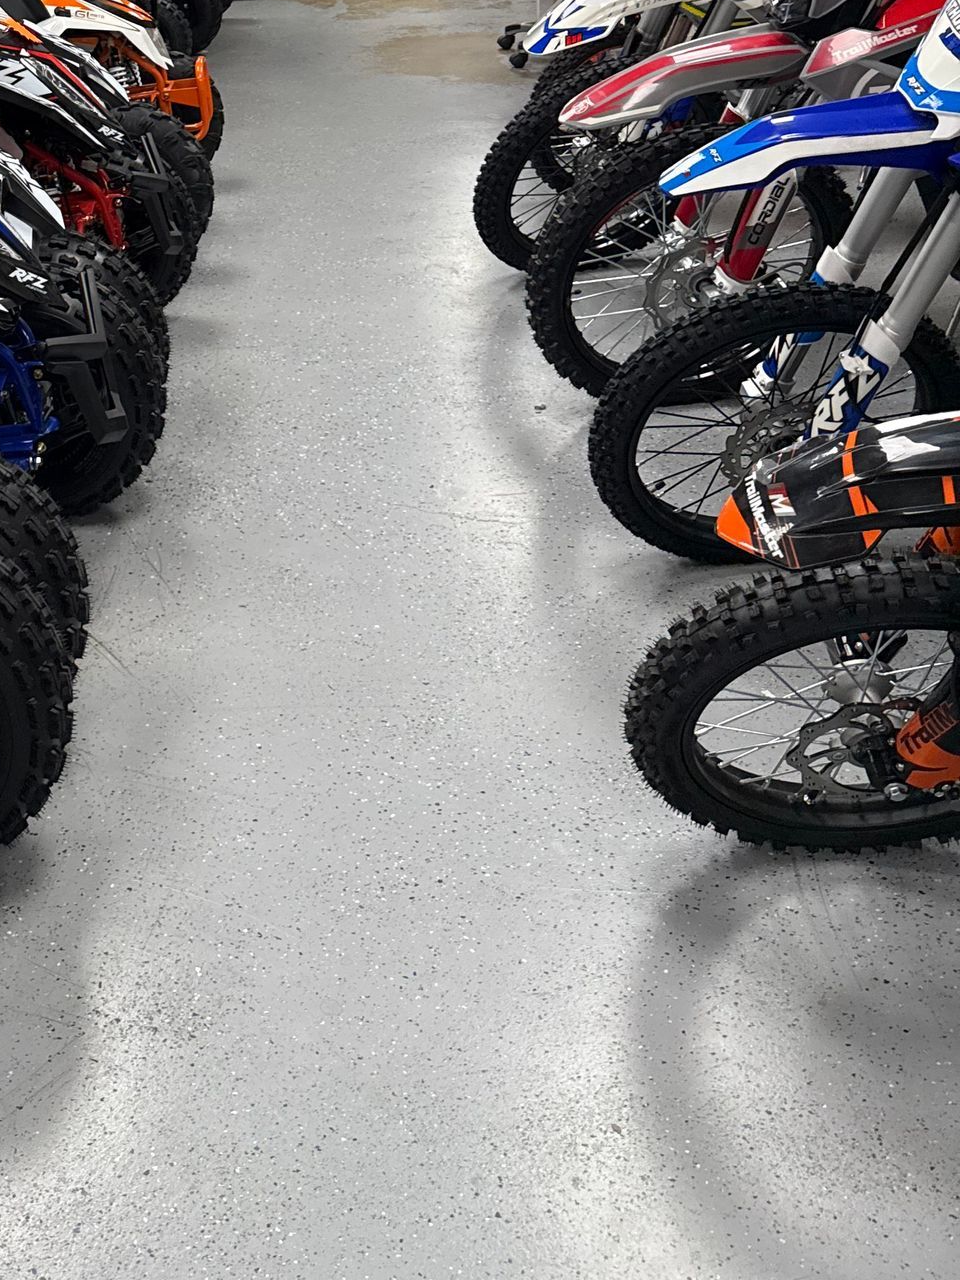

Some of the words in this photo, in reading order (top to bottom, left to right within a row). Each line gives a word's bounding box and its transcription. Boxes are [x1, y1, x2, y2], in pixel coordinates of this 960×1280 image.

[831, 24, 919, 61] TrailMaster
[906, 76, 926, 95] RFZ
[96, 124, 126, 141] RFZ
[709, 148, 722, 162] RFZ
[748, 176, 791, 245] CORDIAL
[8, 266, 48, 289] RFZ
[744, 472, 784, 559] TrailMaster
